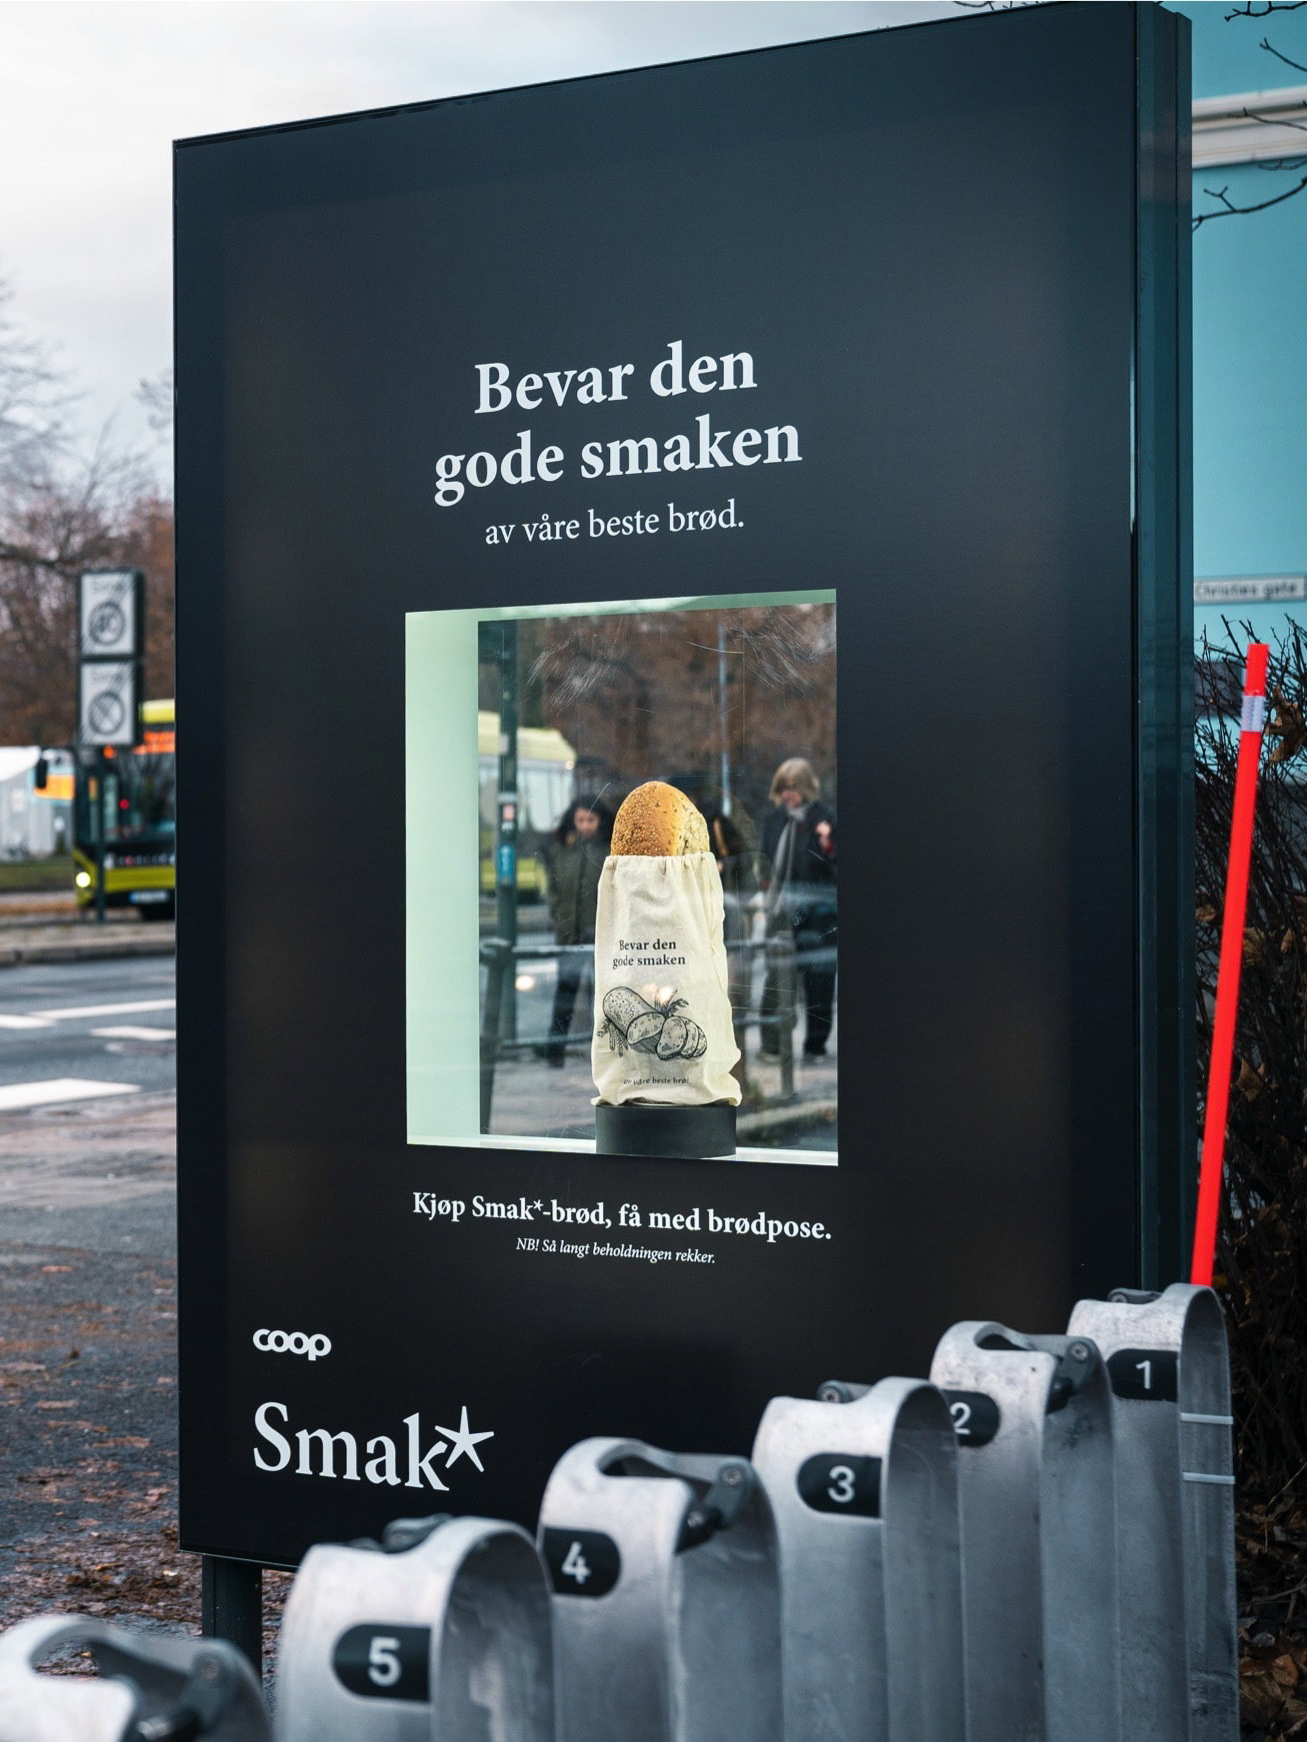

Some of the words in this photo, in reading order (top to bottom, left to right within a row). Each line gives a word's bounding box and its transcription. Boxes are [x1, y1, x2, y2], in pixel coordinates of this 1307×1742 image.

[474, 362, 635, 414] Bevar
[649, 339, 758, 397] den
[434, 429, 565, 507] gode
[580, 413, 803, 479] smaken
[485, 524, 516, 545] av
[521, 513, 580, 542] våre
[587, 508, 660, 538] beste
[666, 497, 745, 533] brød.
[612, 954, 634, 969] gode
[637, 953, 686, 966] smaken
[619, 939, 650, 951] Bevar
[652, 938, 677, 950] den
[412, 1191, 466, 1223] Kjøp
[618, 1202, 643, 1228] få
[648, 1207, 702, 1231] med
[706, 1208, 832, 1244] brødpose.
[515, 1236, 540, 1252] NB!
[541, 1238, 557, 1253] Så
[559, 1239, 590, 1259] langt
[592, 1241, 672, 1264] beholdningen
[674, 1248, 716, 1264] rekker.
[252, 1328, 332, 1362] coop
[1136, 1360, 1151, 1389] 1
[950, 1402, 971, 1434] 2
[828, 1465, 855, 1503] 3
[561, 1541, 591, 1584] 4
[368, 1636, 401, 1687] 5
